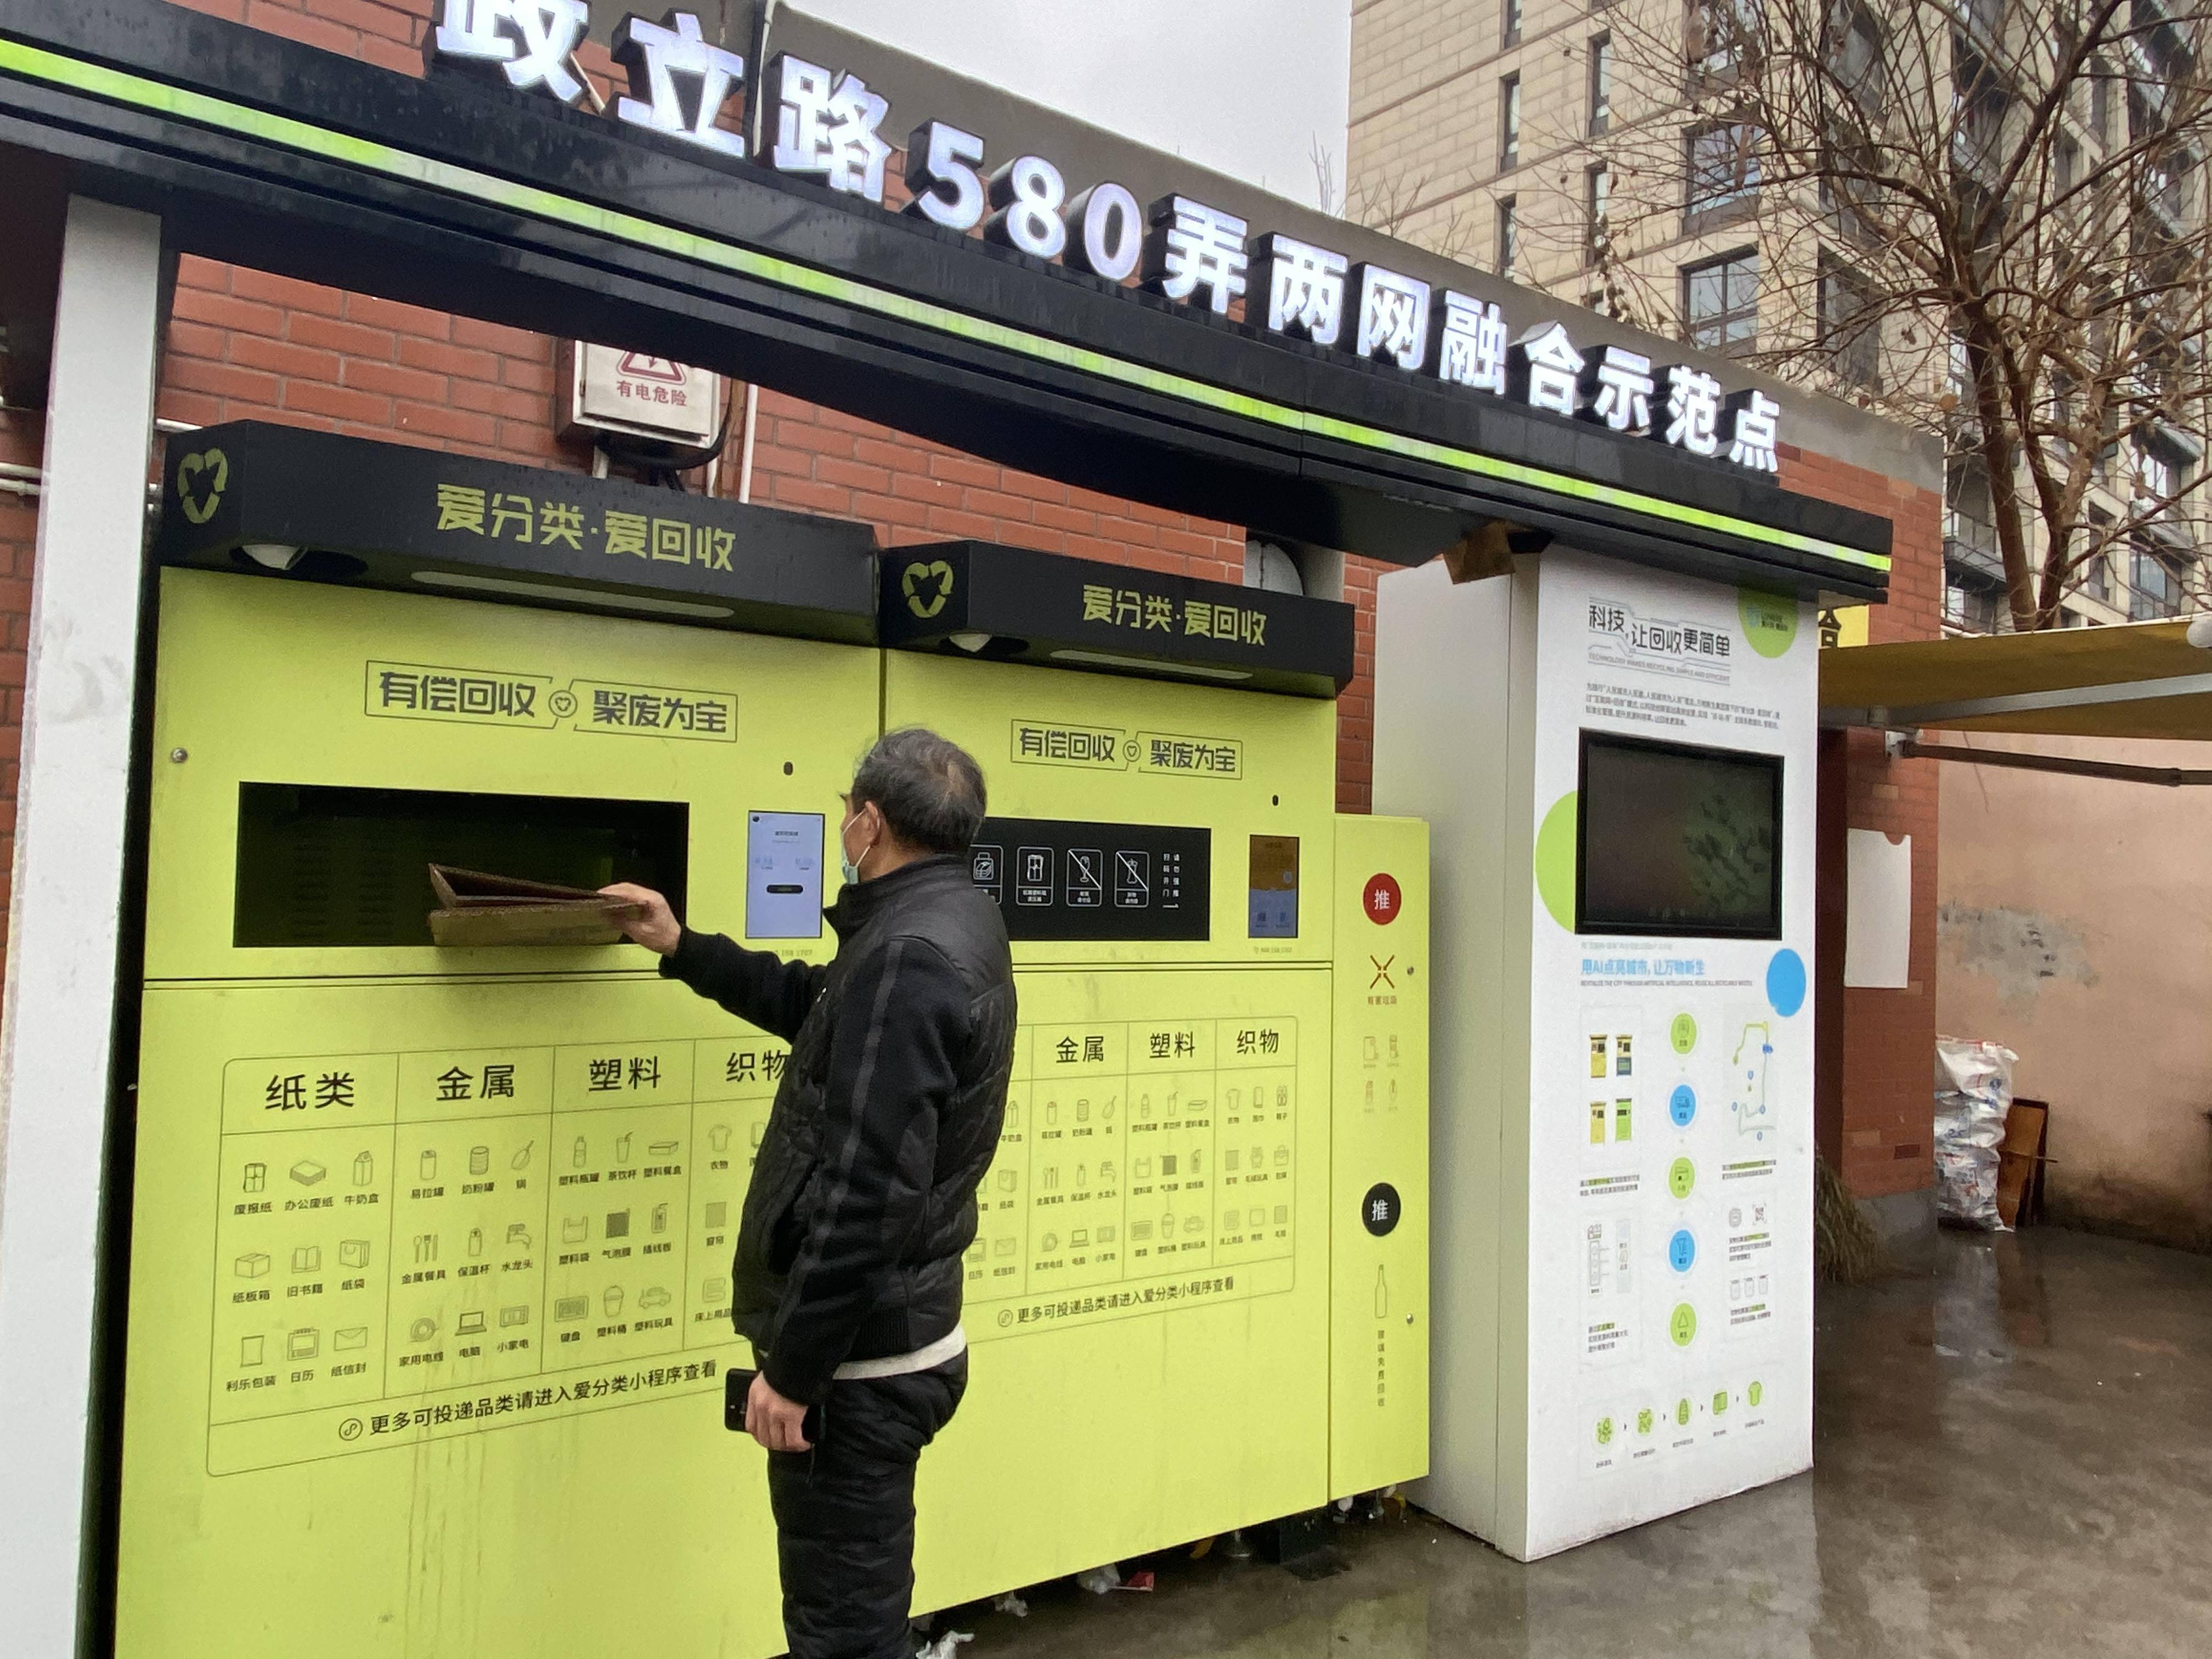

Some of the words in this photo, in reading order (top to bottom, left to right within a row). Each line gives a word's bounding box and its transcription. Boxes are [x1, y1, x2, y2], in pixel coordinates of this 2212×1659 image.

[617, 380, 686, 407] 有电危险
[436, 483, 736, 573] 爱分类·爱回收
[1082, 584, 1267, 646] 爱分类·爱回收
[380, 672, 536, 718] 有偿回收
[592, 690, 727, 734] 聚废为宝
[1020, 727, 1115, 763] 有偿回收
[1150, 740, 1237, 773] 聚废为宝
[1374, 889, 1390, 910] 推
[1056, 1036, 1103, 1063] 金属
[1150, 1031, 1195, 1058] 塑料
[1237, 1029, 1278, 1054] 织物
[726, 1049, 785, 1082] 织物
[589, 1056, 661, 1092] 塑料
[266, 1072, 354, 1110] 纸类
[437, 1065, 514, 1101] 金属
[411, 1187, 444, 1199] 易拉罐
[462, 1182, 494, 1194] 奶粉罐
[285, 1197, 334, 1211] 办公废纸
[345, 1193, 379, 1205] 牛奶盒
[234, 1202, 272, 1215] 废报纸
[1372, 1199, 1387, 1221] 推
[458, 1264, 490, 1277] 保温杯
[502, 1259, 533, 1272] 水龙头
[342, 1279, 364, 1290] 纸袋
[402, 1270, 445, 1284] 金属餐具
[233, 1290, 270, 1303] 纸板箱
[287, 1284, 323, 1297] 旧书籍
[1017, 1276, 1234, 1324] 更多可投递品类请进入爱分类小程序查看
[459, 1346, 480, 1358] 电脑
[497, 1339, 528, 1352] 小家电
[399, 1351, 443, 1367] 家用电线
[291, 1370, 314, 1383] 日历
[331, 1362, 366, 1376] 纸信封
[227, 1375, 276, 1391] 利乐包装
[370, 1359, 717, 1436] 更多可投递品类请进入爱分类小程序查看
